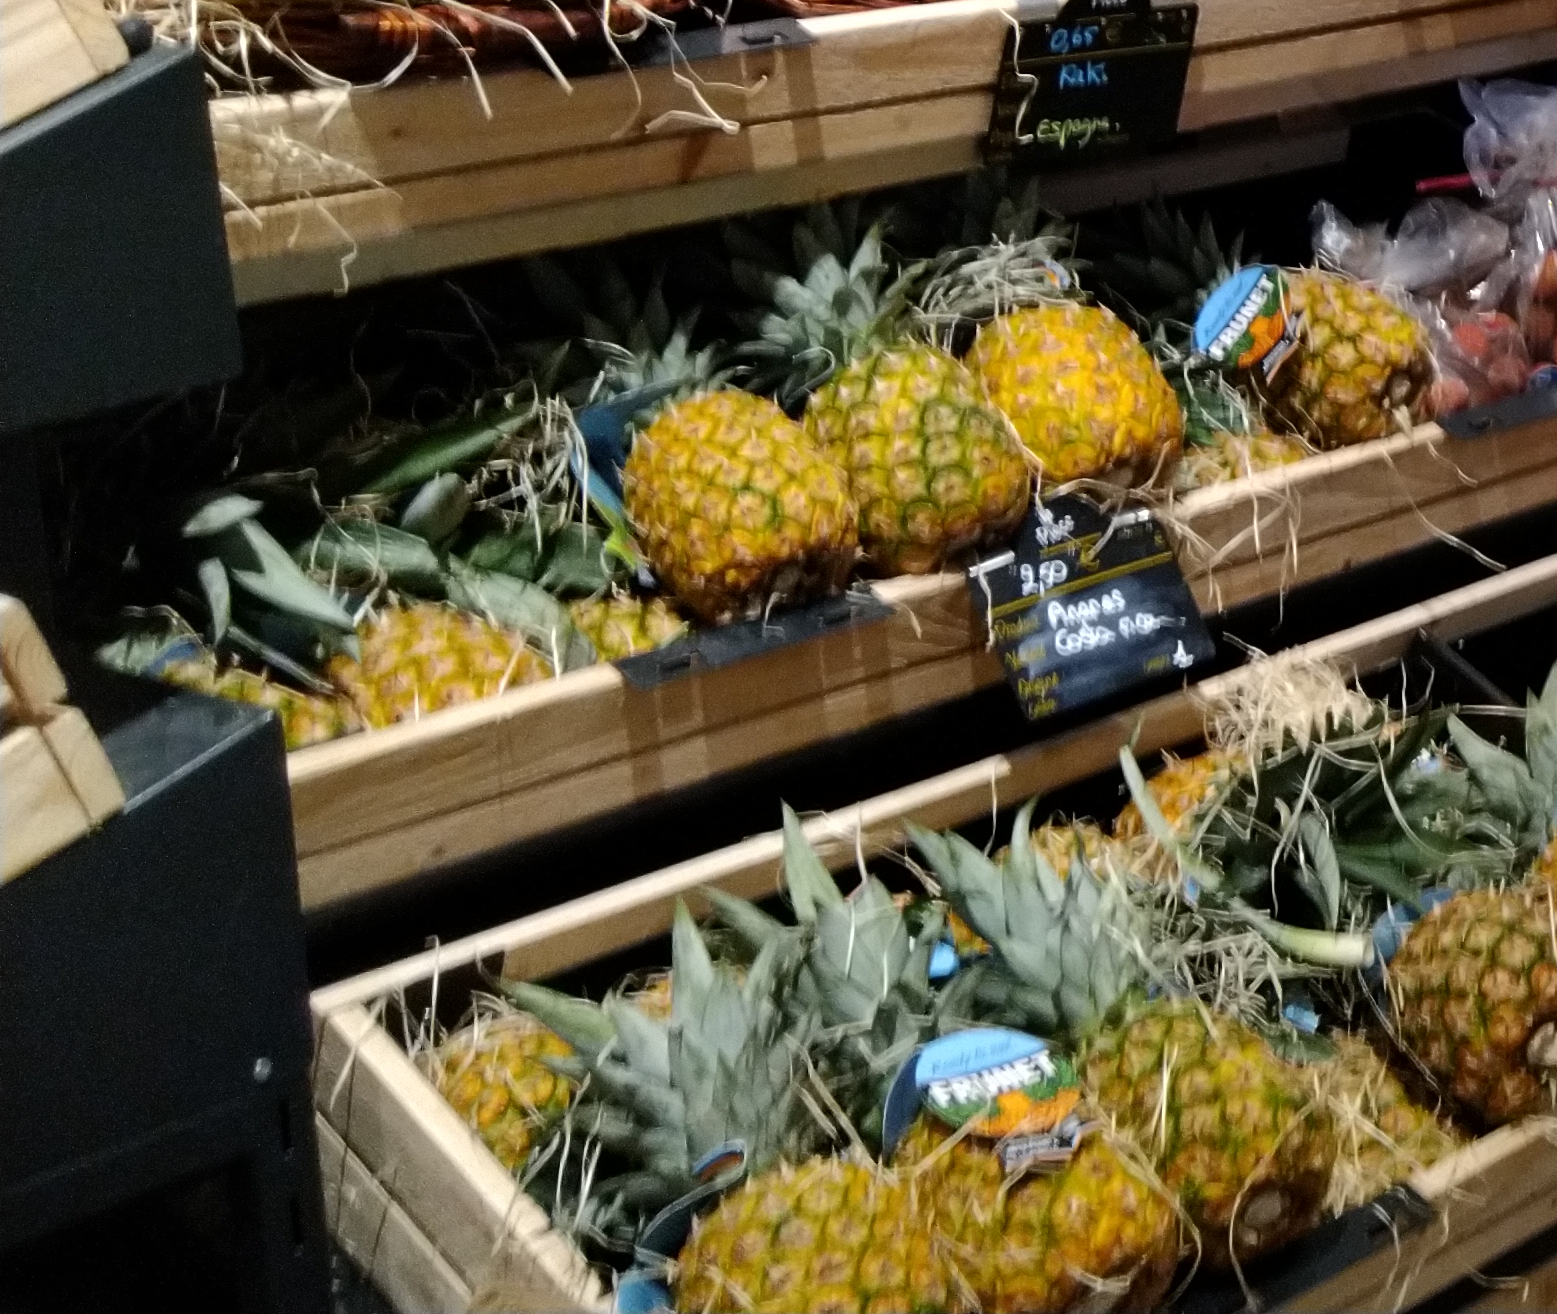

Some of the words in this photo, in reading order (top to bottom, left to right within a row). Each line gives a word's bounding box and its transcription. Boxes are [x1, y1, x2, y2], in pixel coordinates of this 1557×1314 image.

[1208, 274, 1275, 362] FRUNET
[1047, 588, 1126, 630] Ananas
[928, 1049, 1058, 1109] FRUNET
